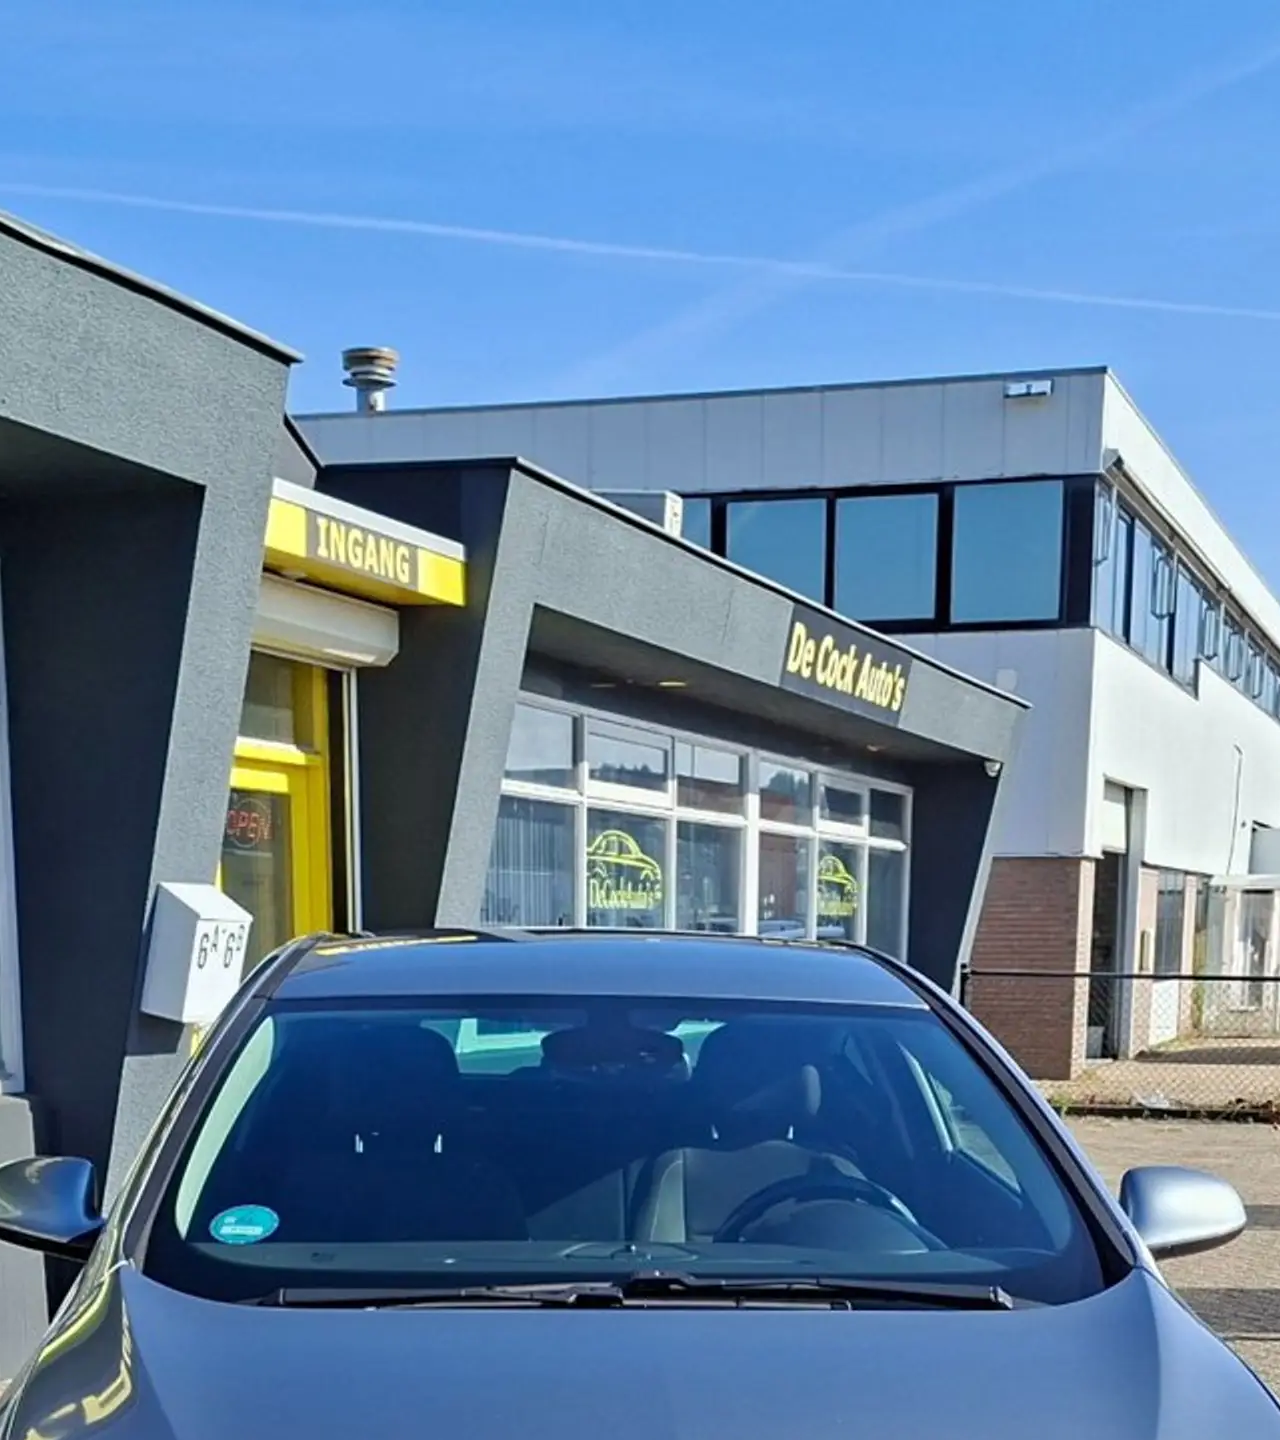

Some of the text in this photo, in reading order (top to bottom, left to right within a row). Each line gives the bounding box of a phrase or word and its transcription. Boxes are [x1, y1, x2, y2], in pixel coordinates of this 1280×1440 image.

[316, 517, 410, 583] INGANG
[786, 621, 905, 712] De Cock Auto's
